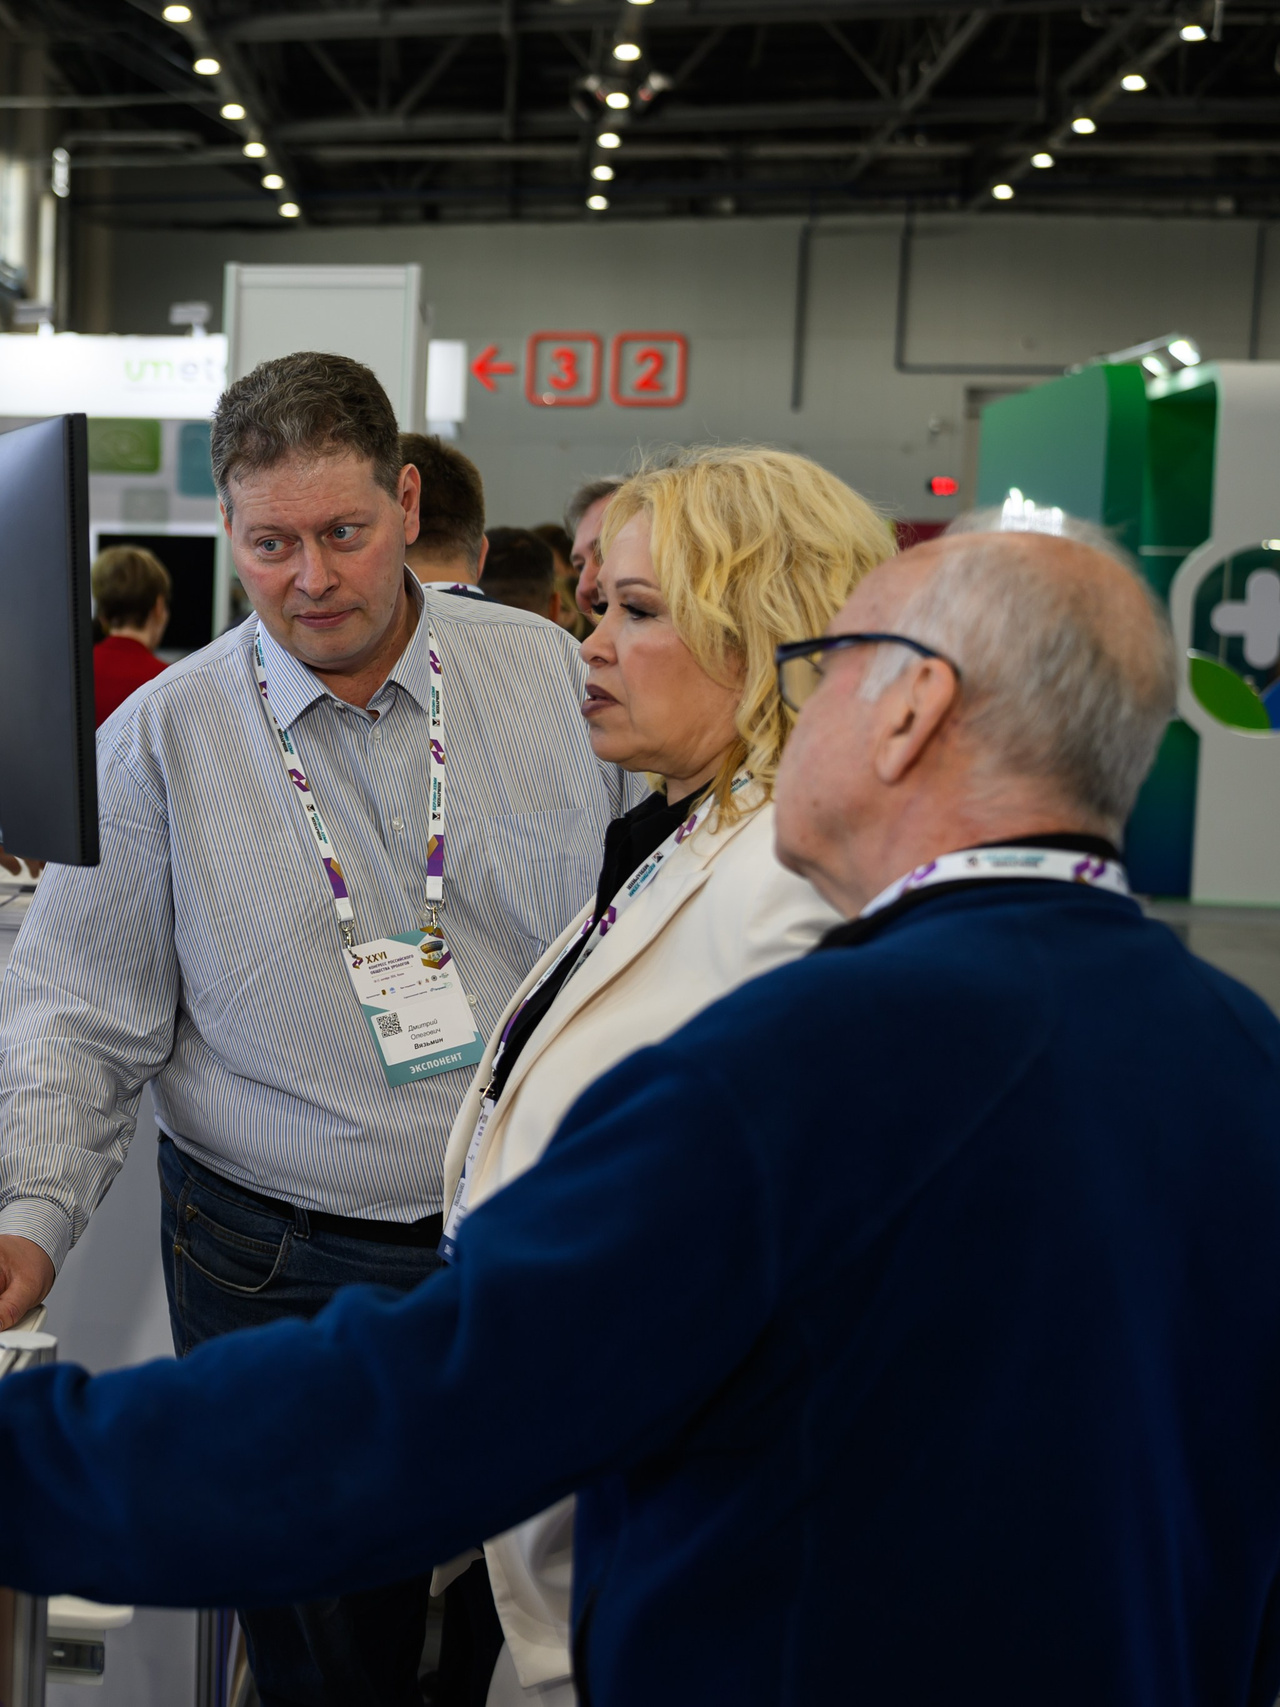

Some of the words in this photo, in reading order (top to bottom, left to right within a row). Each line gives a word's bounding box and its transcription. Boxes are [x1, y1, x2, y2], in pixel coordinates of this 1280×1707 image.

[548, 346, 579, 391] 3
[634, 346, 665, 392] 2
[365, 951, 388, 965] XXVI
[408, 1019, 438, 1033] Дмитрий
[411, 1028, 441, 1041] Олегович
[414, 1037, 444, 1050] Вязьмин
[409, 1052, 463, 1075] ЭКСПОНЕНТ
